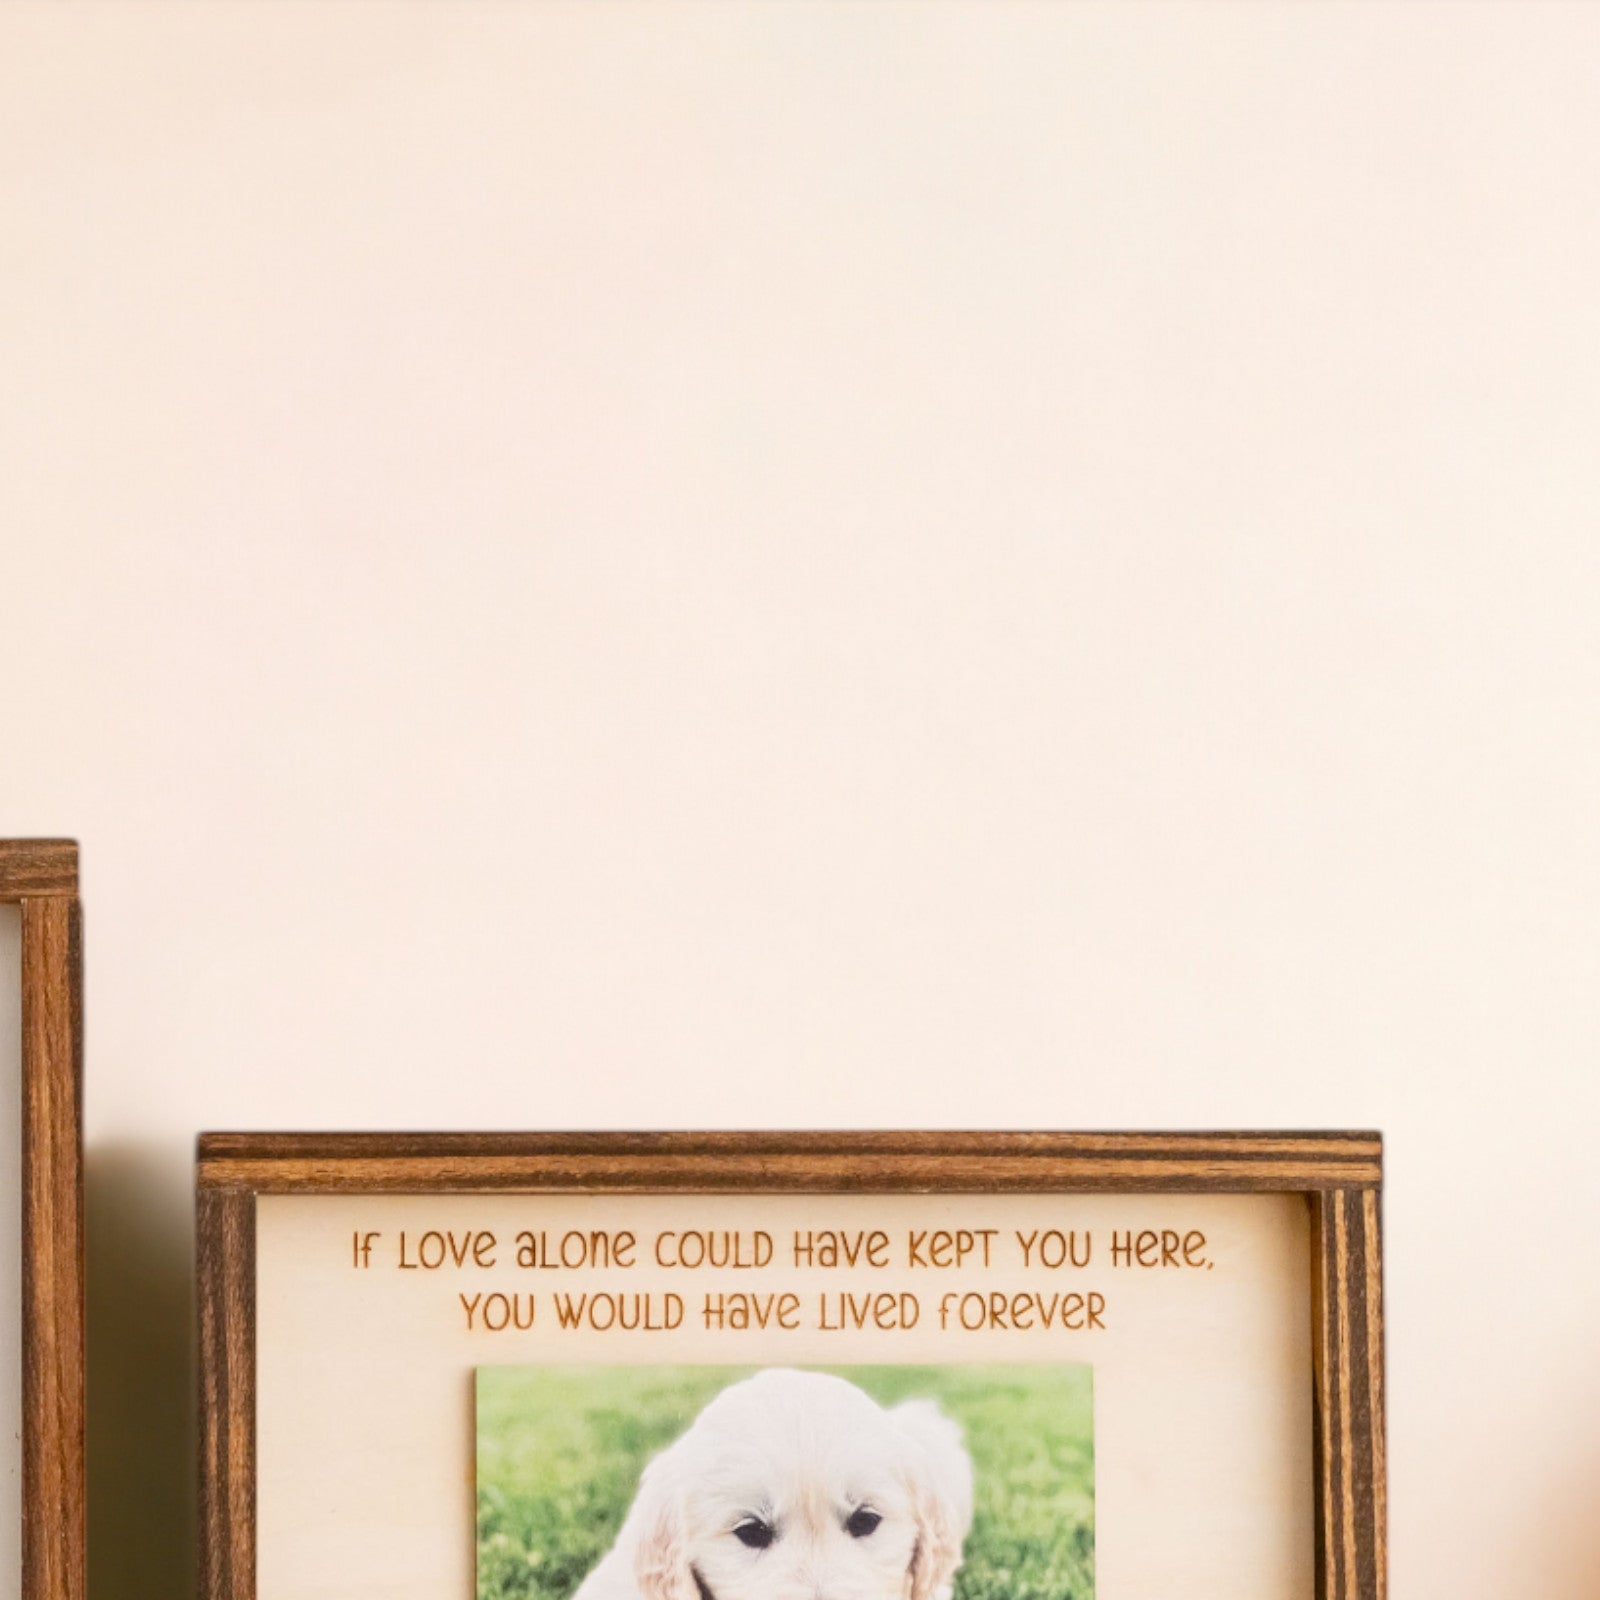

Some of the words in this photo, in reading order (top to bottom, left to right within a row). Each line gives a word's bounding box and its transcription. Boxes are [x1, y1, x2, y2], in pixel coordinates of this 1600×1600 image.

[654, 1230, 774, 1269] COULD
[1014, 1228, 1092, 1270] YOU
[458, 1291, 535, 1332] YOU
[552, 1292, 685, 1332] WOULD
